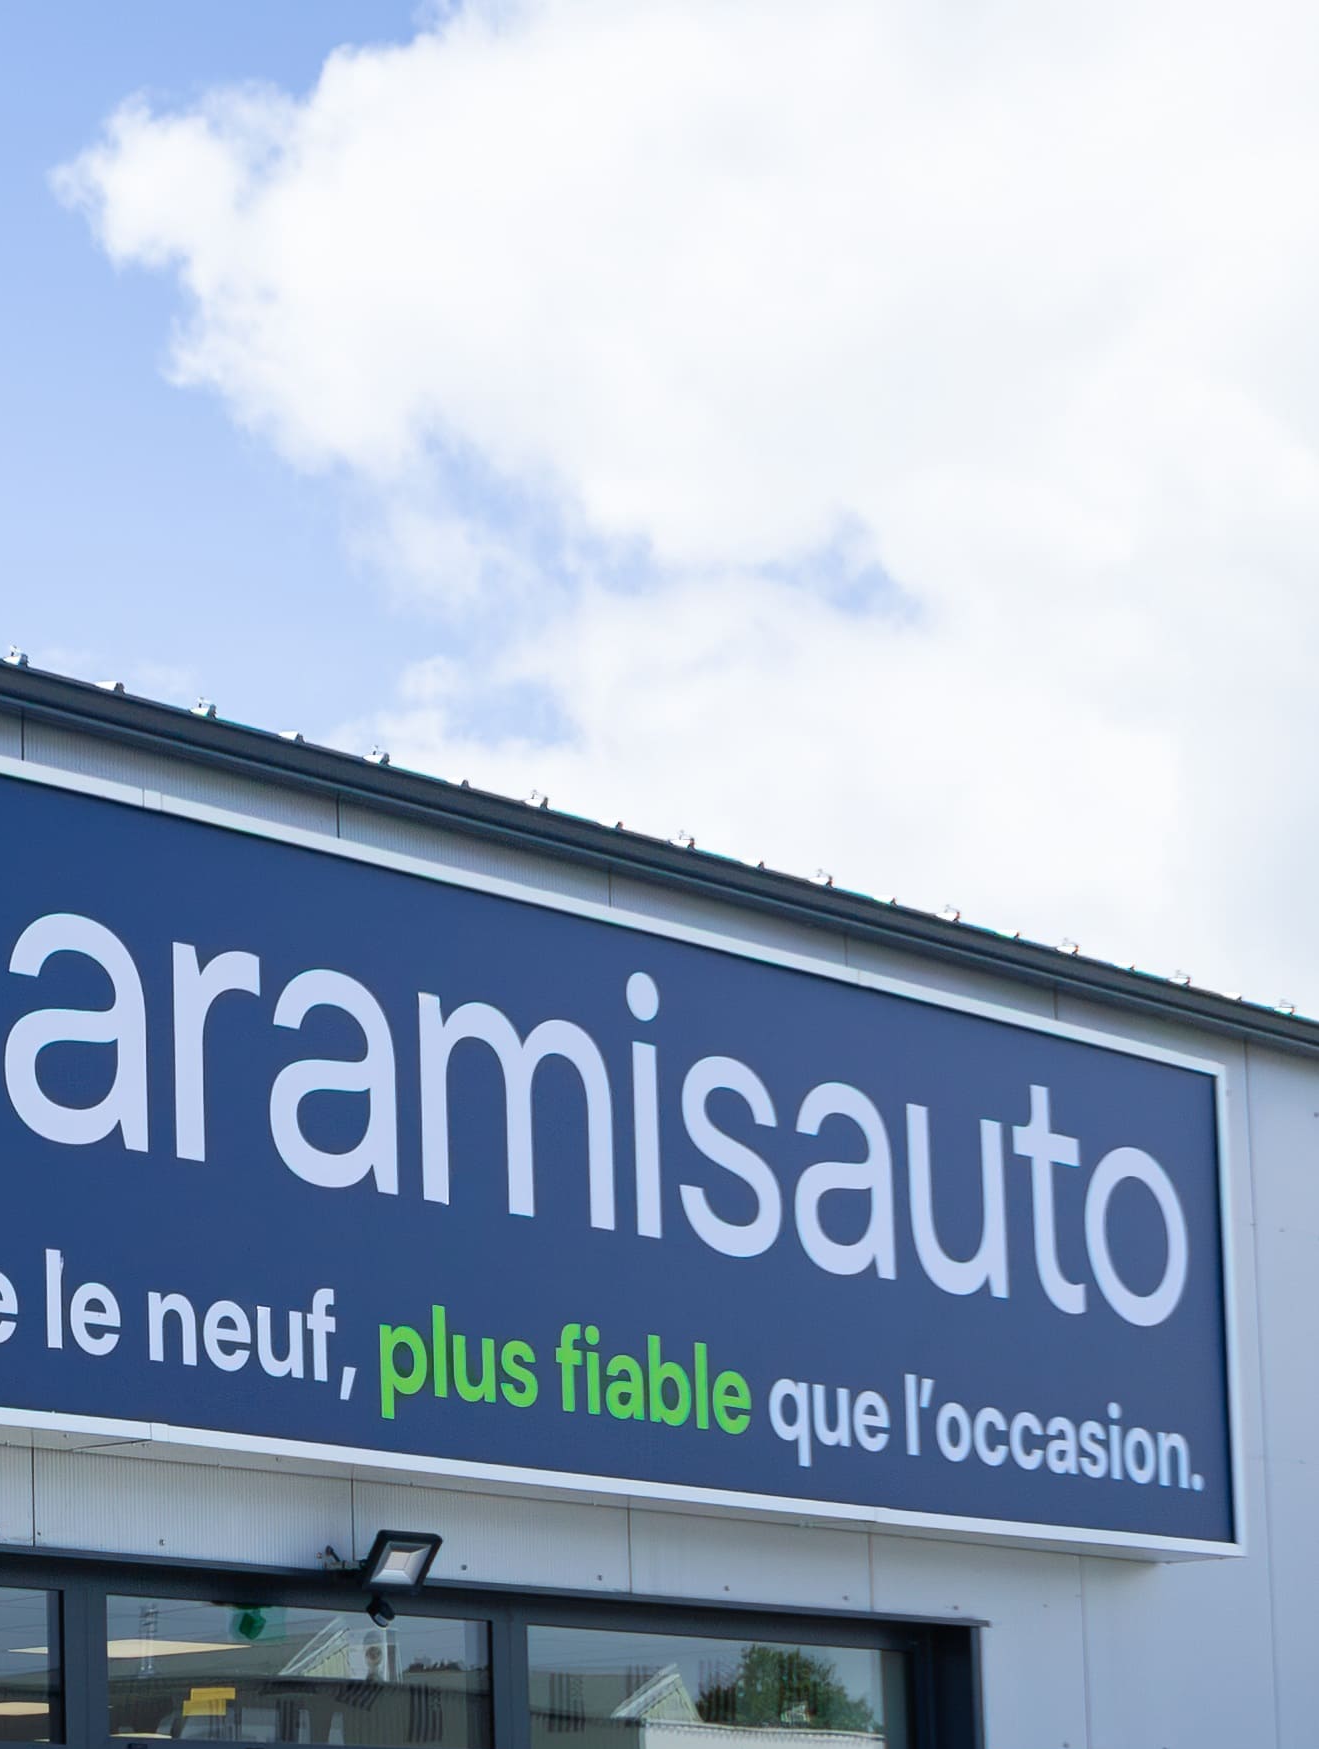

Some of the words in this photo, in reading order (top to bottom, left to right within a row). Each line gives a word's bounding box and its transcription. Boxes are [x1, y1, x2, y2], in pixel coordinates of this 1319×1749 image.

[3, 911, 1190, 1328] aramisauto
[45, 1248, 121, 1356] le
[147, 1287, 357, 1401] neuf,
[379, 1304, 539, 1420] plus
[555, 1323, 753, 1436] fiable
[767, 1377, 891, 1468] que
[903, 1373, 1206, 1492] l’occasion.
